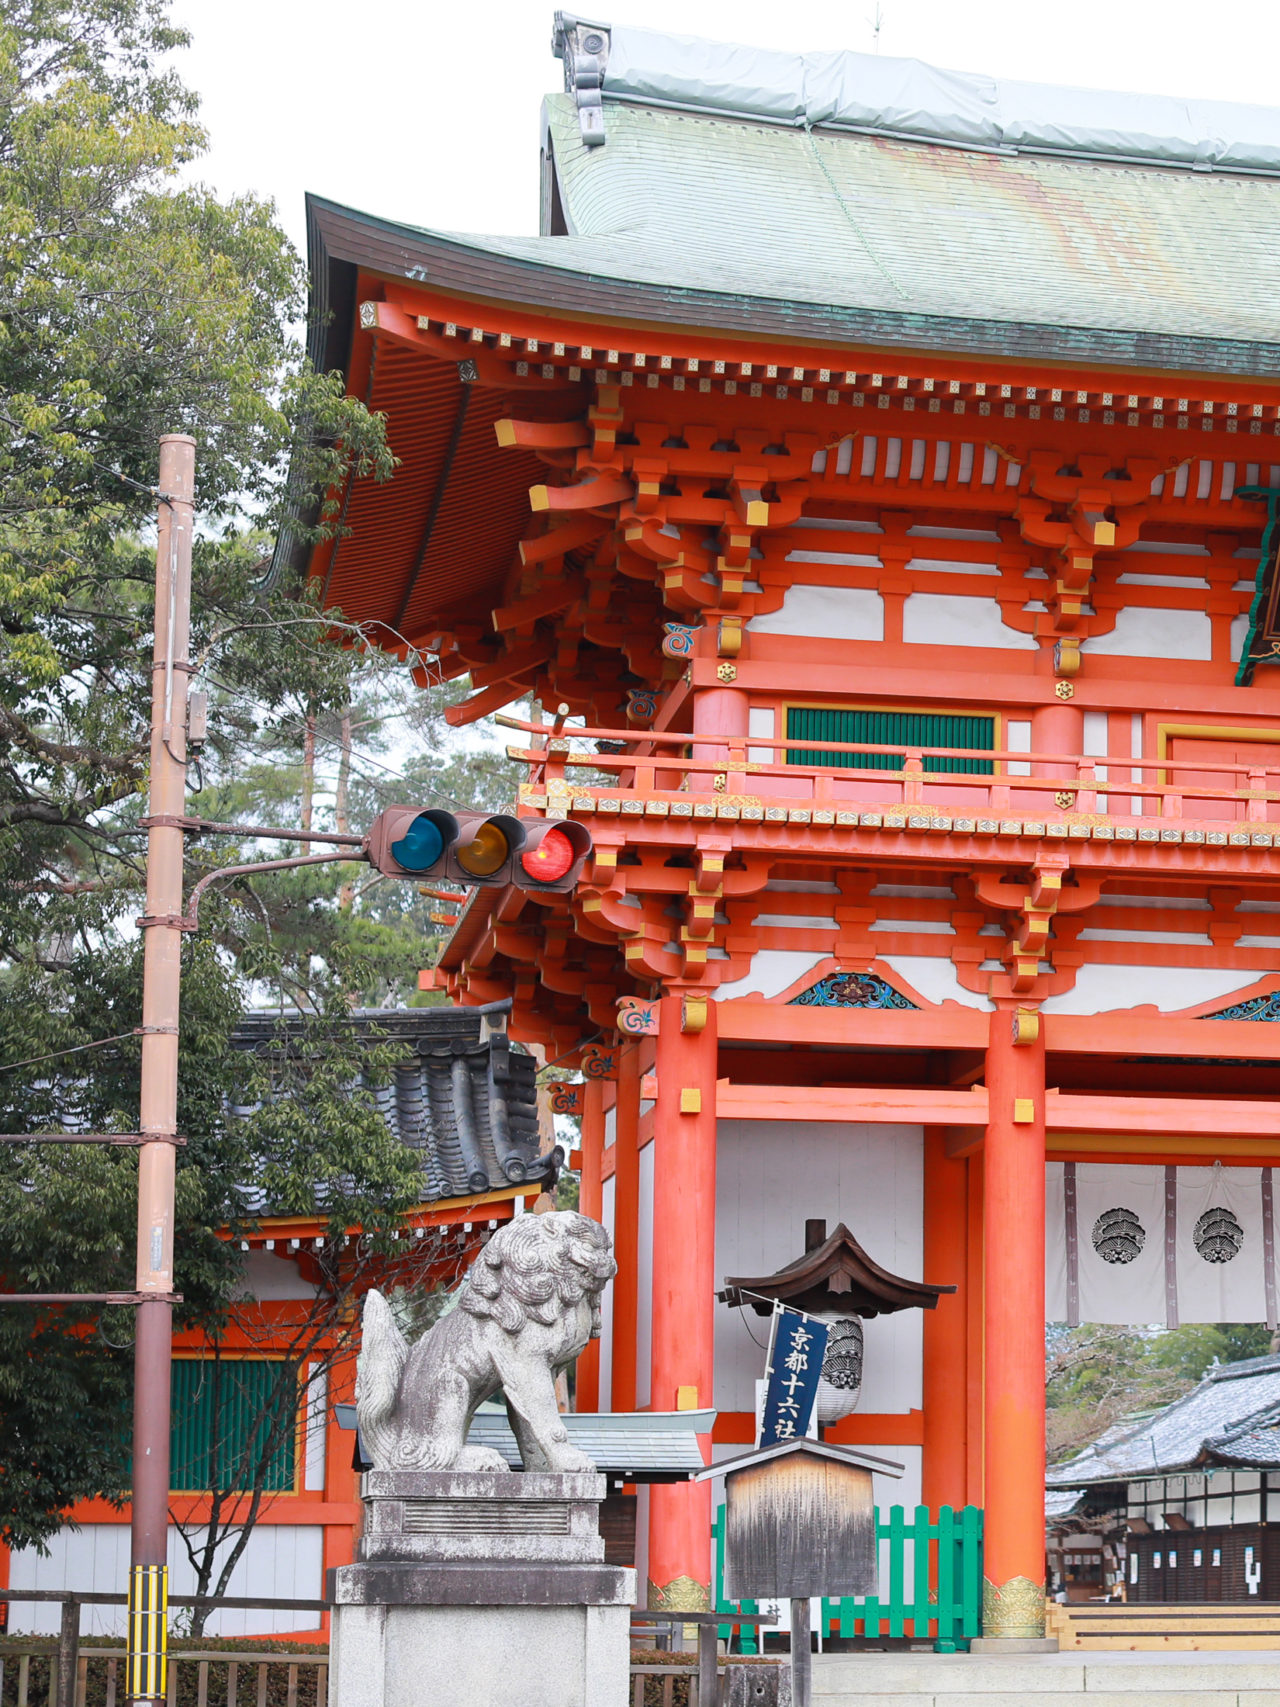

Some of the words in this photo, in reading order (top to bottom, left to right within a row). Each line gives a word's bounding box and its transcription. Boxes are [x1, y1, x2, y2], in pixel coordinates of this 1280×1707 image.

[774, 1326, 814, 1443] 京都十六社
